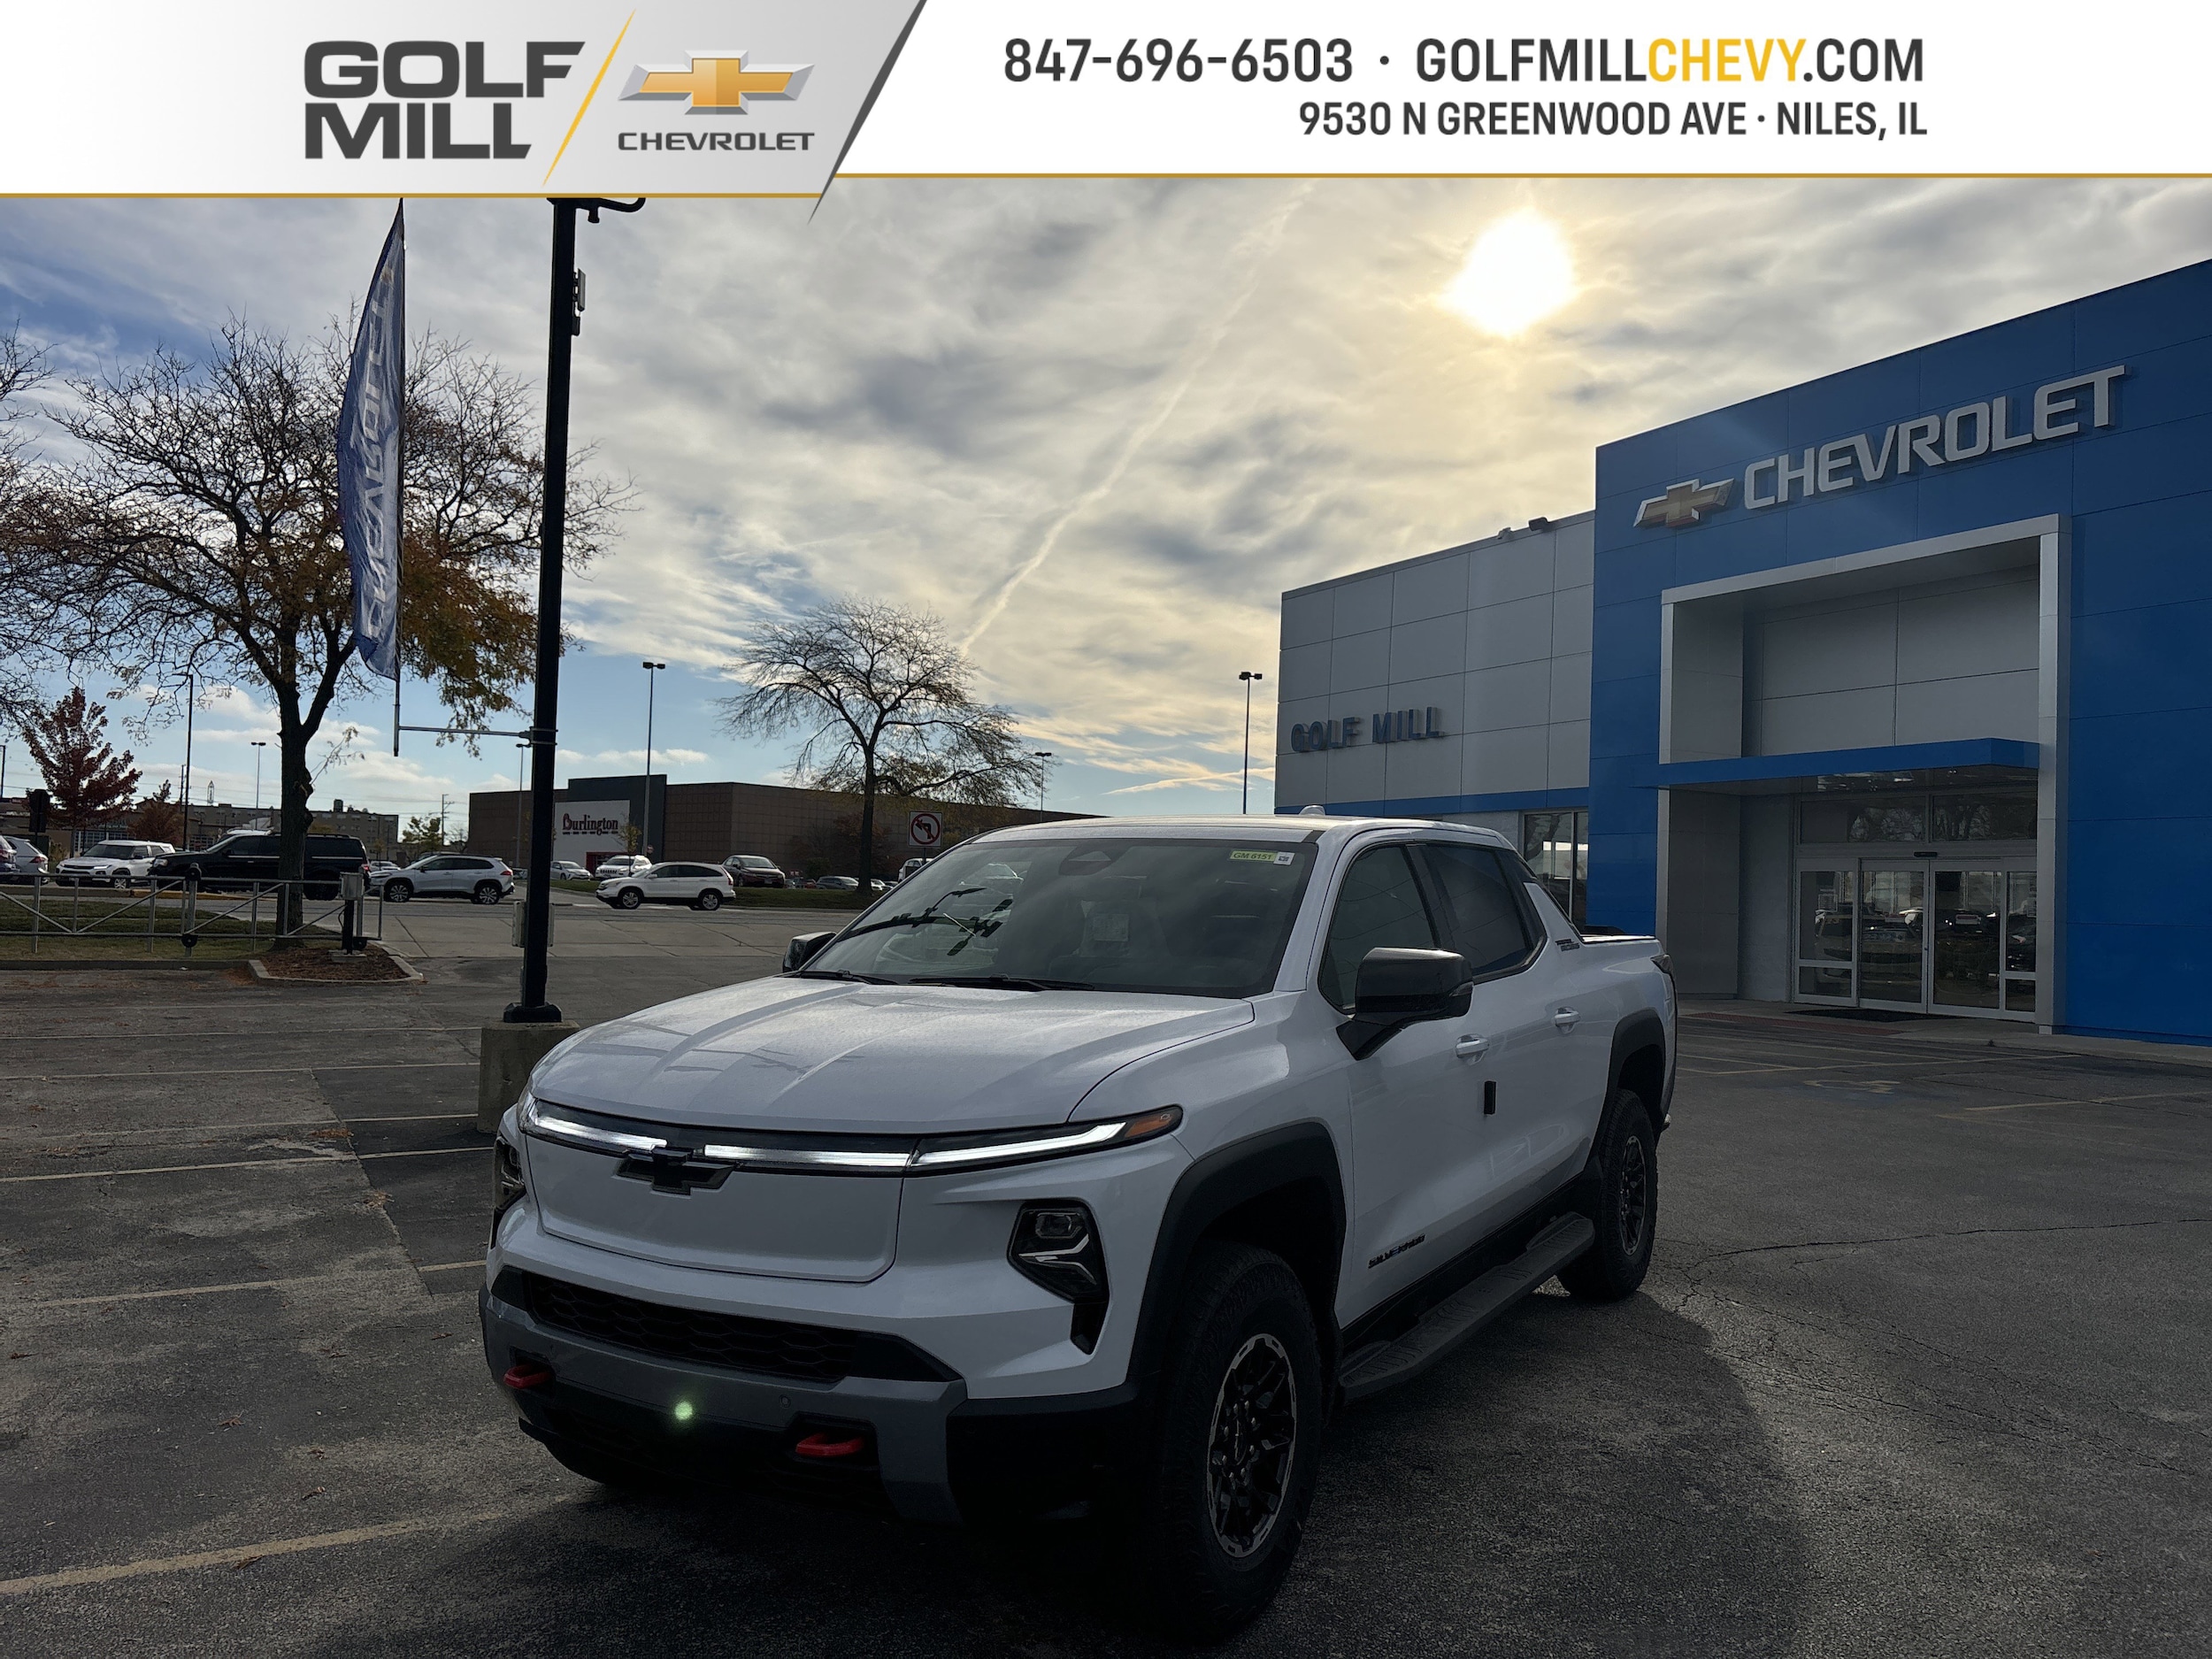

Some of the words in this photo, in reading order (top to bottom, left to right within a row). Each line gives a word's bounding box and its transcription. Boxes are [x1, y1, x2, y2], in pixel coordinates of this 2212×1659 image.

[1744, 364, 2129, 511] CHEVROLET
[1290, 716, 1360, 753] GOLF
[1371, 706, 1445, 744] MILL
[562, 812, 618, 835] Burlington
